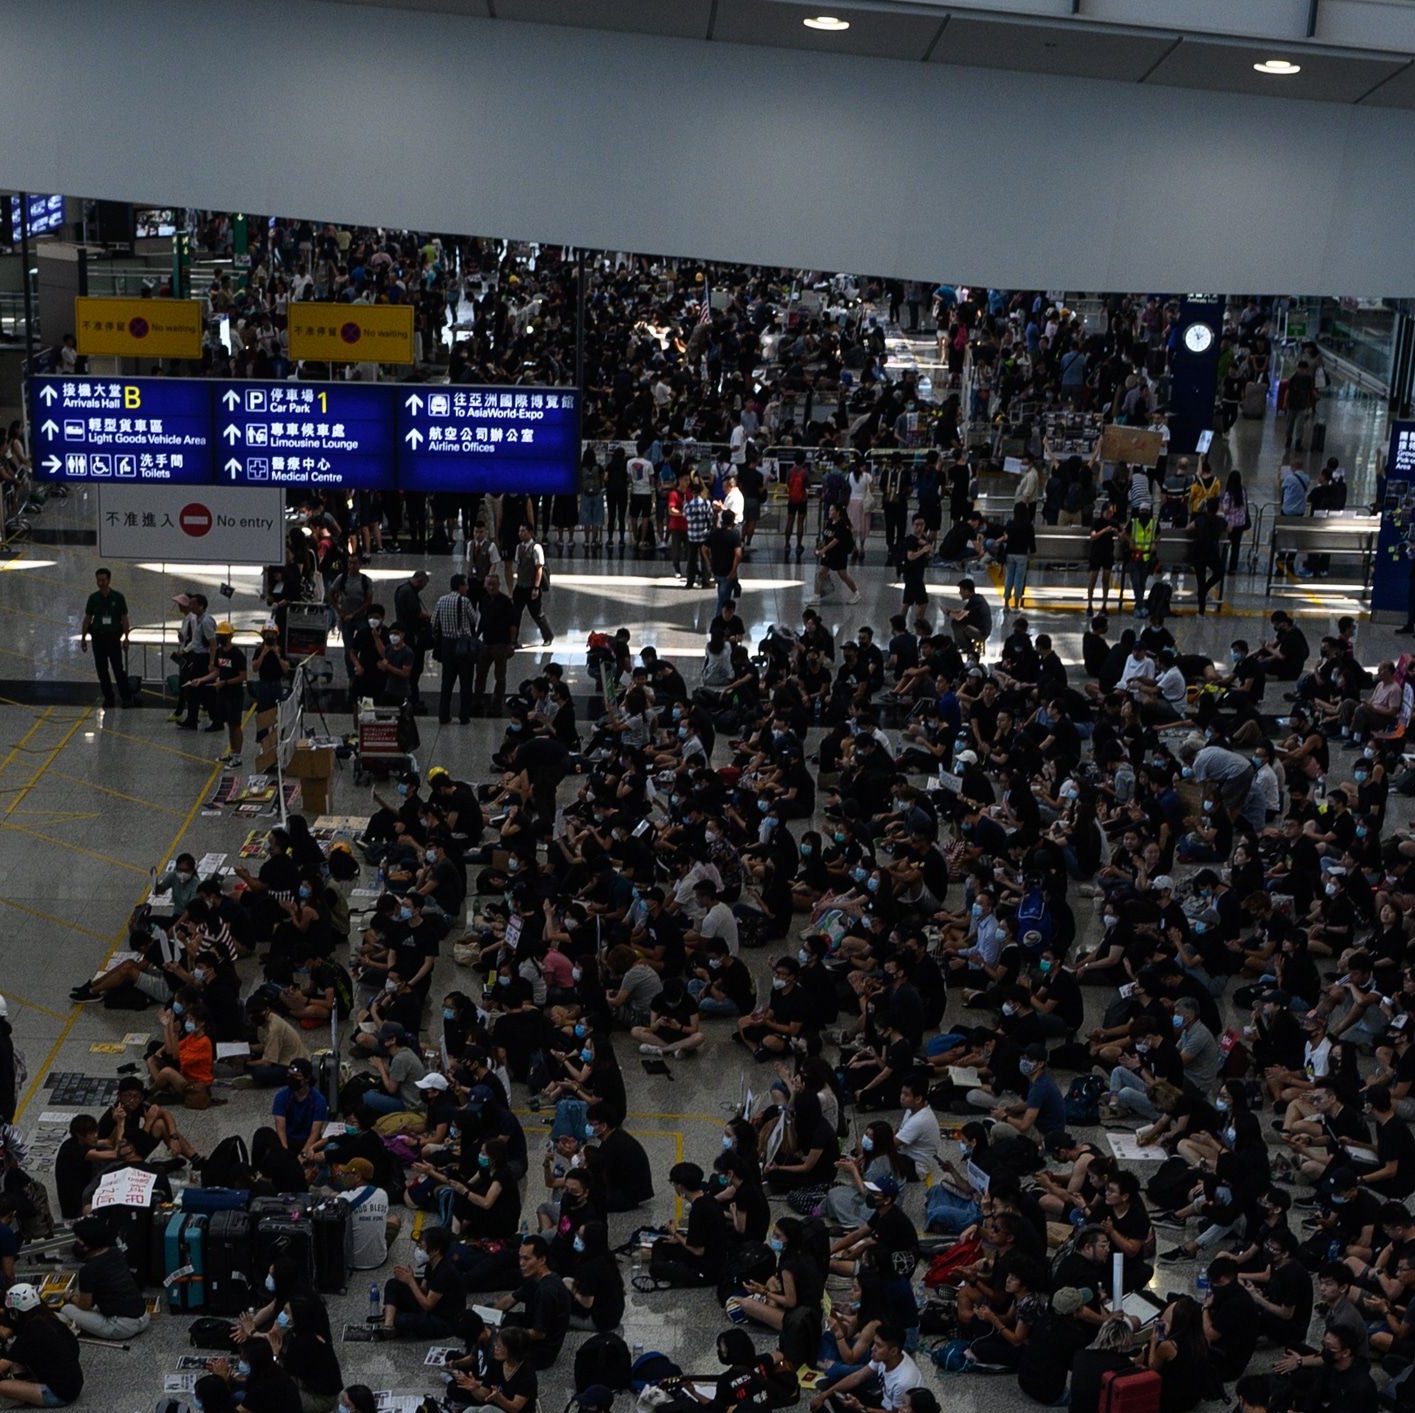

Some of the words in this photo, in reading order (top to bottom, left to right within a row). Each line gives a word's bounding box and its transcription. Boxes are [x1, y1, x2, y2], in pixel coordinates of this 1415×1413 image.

[152, 323, 163, 332] No
[363, 329, 375, 338] No
[377, 329, 408, 340] waiting
[63, 383, 121, 397] 接機大堂
[124, 386, 141, 408] B
[270, 388, 314, 403] 停車場
[63, 398, 100, 408] Arrivals
[102, 399, 120, 408] Hall
[318, 392, 327, 414] 1
[454, 392, 574, 409] 往亞洲國際博覽館
[270, 403, 287, 413] Car
[290, 404, 310, 413] Park
[454, 407, 465, 417] To
[467, 408, 544, 420] AsiaWorld-Expo
[88, 418, 163, 433] 輕型貨車區
[89, 434, 112, 445] Light
[115, 434, 146, 444] Goods
[148, 435, 181, 445] Vehicle
[183, 435, 206, 445] Area
[428, 426, 534, 442] 航空公司辦公室
[270, 438, 320, 448] Limousine
[323, 439, 358, 451] Lounge
[428, 442, 459, 452] Airline
[462, 442, 495, 453] Offices
[140, 454, 184, 468] 洗手間
[271, 457, 331, 471] 醫療中心
[140, 468, 170, 478] Toilets
[272, 471, 308, 481] Medical
[311, 473, 342, 482] Centre
[106, 511, 174, 528] 不准進入
[217, 514, 235, 527] No
[240, 515, 274, 530] entry
